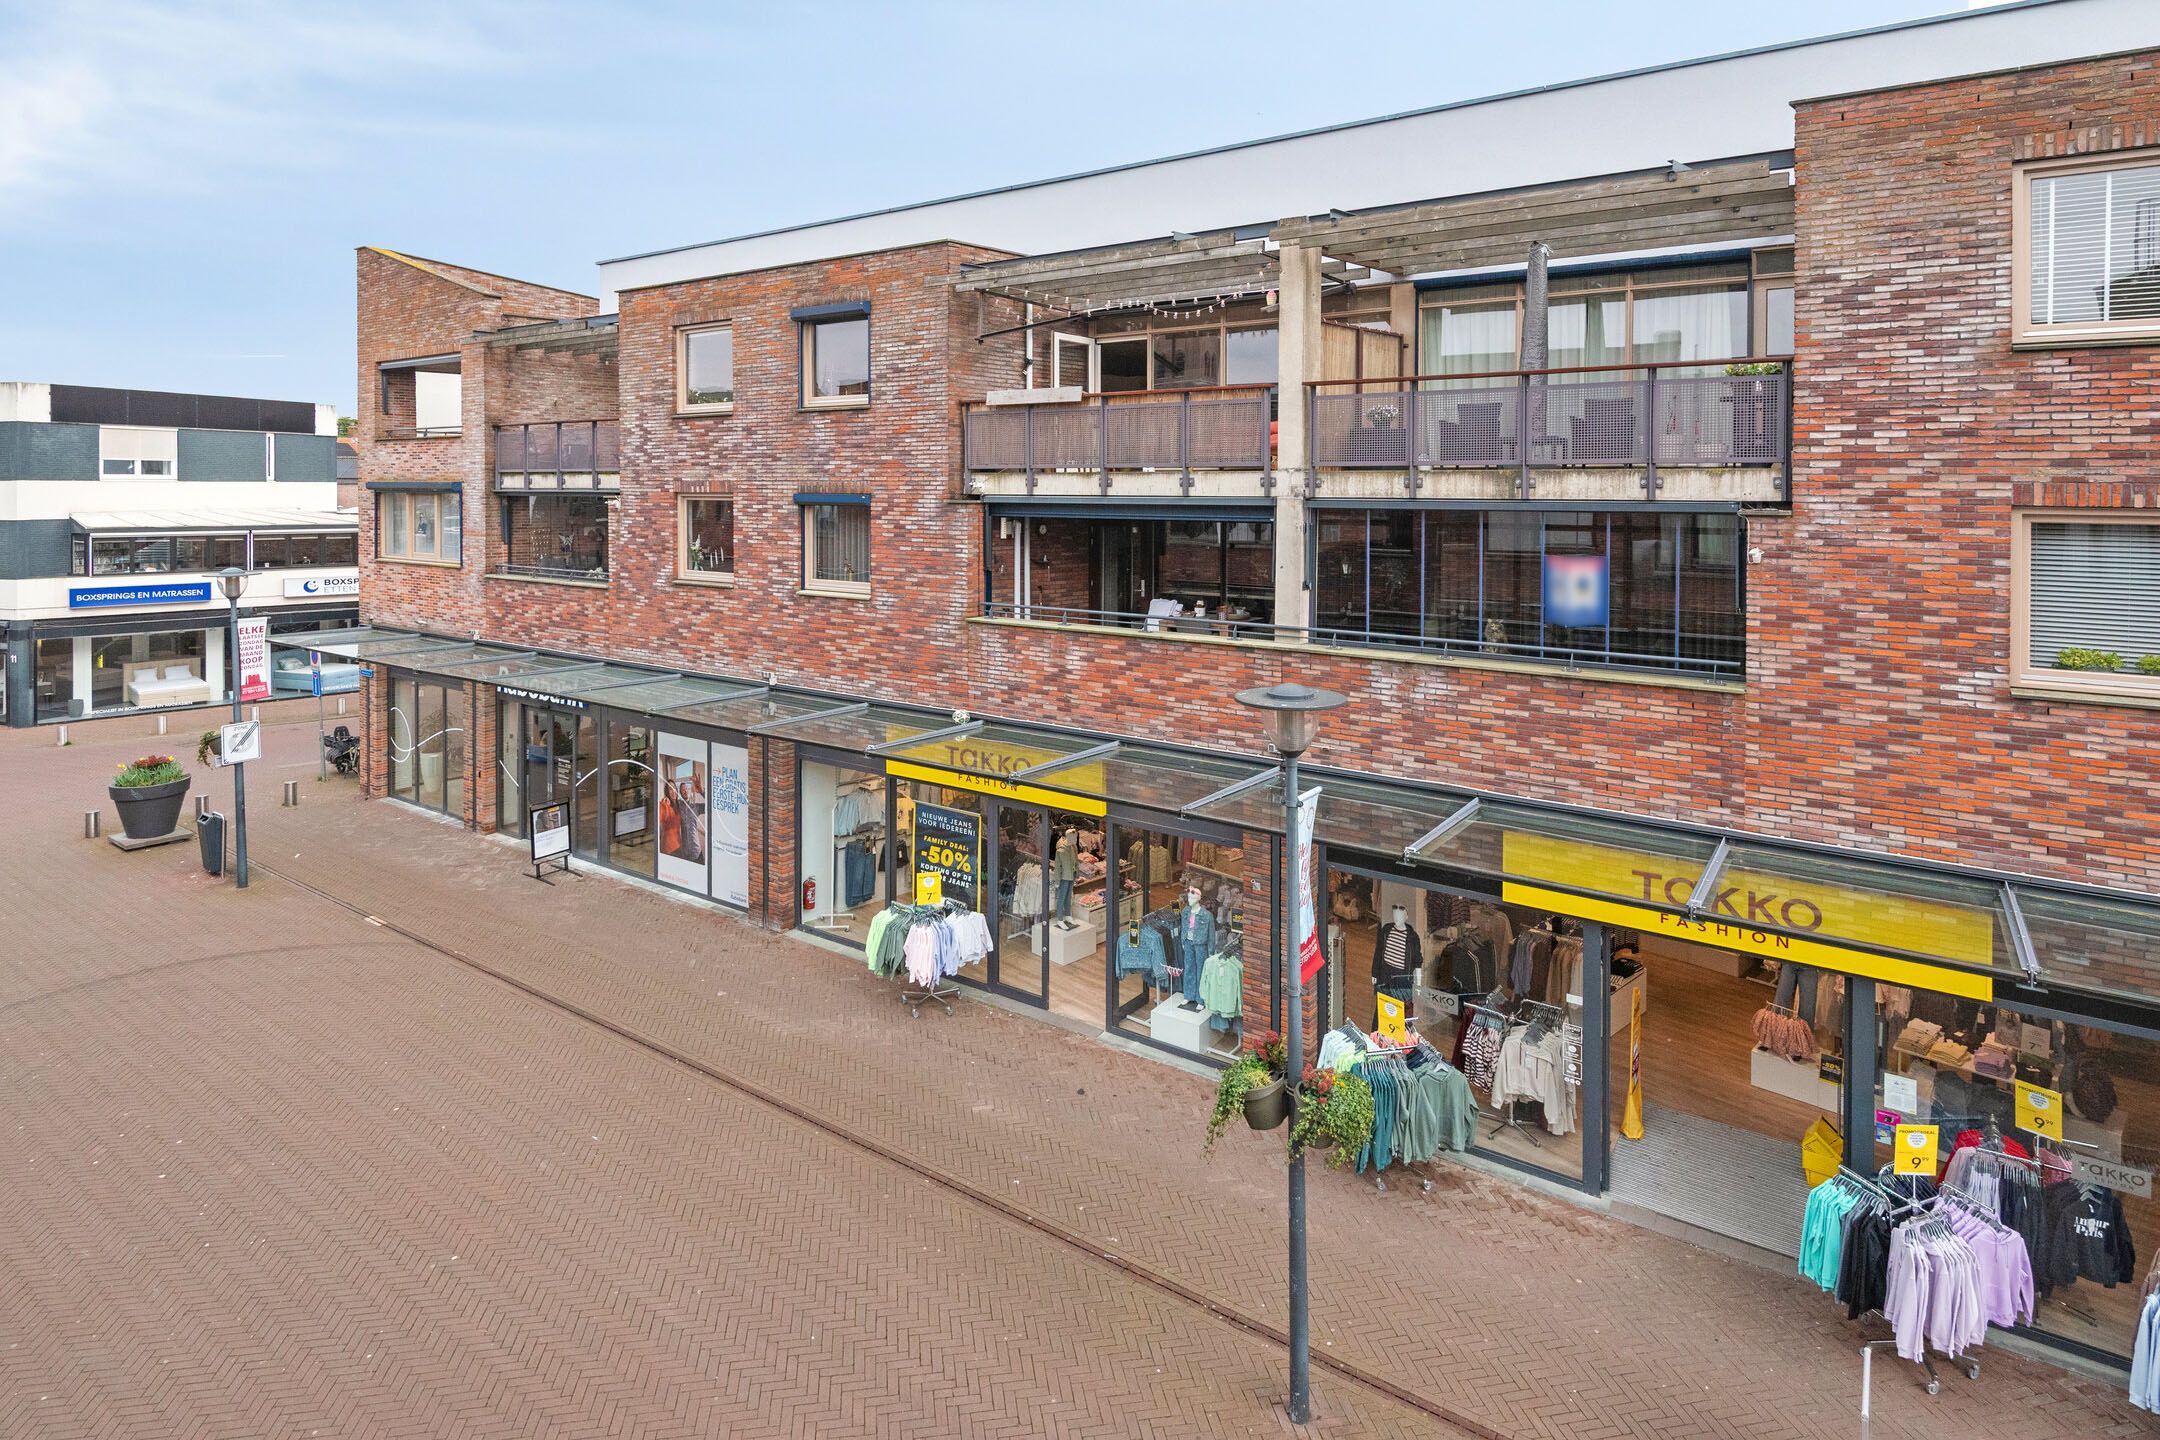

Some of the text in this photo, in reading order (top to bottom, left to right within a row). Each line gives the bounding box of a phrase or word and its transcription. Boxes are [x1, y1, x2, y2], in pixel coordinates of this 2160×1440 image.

[76, 589, 203, 601] BOXSPRINGS EN MATRASSEN
[240, 625, 264, 634] ELKE
[240, 656, 263, 665] KOOP
[722, 766, 738, 779] PLAN
[958, 773, 1017, 791] FASHION
[919, 817, 976, 837] VOOR IEDEREEN!
[921, 811, 972, 829] NIEUWE JEANS
[923, 835, 969, 852] FAMILY DEAL:
[921, 845, 971, 873] -50%
[920, 862, 950, 876] KORTING
[951, 871, 961, 879] OP
[963, 873, 972, 882] DE
[1660, 913, 1790, 949] FASHION
